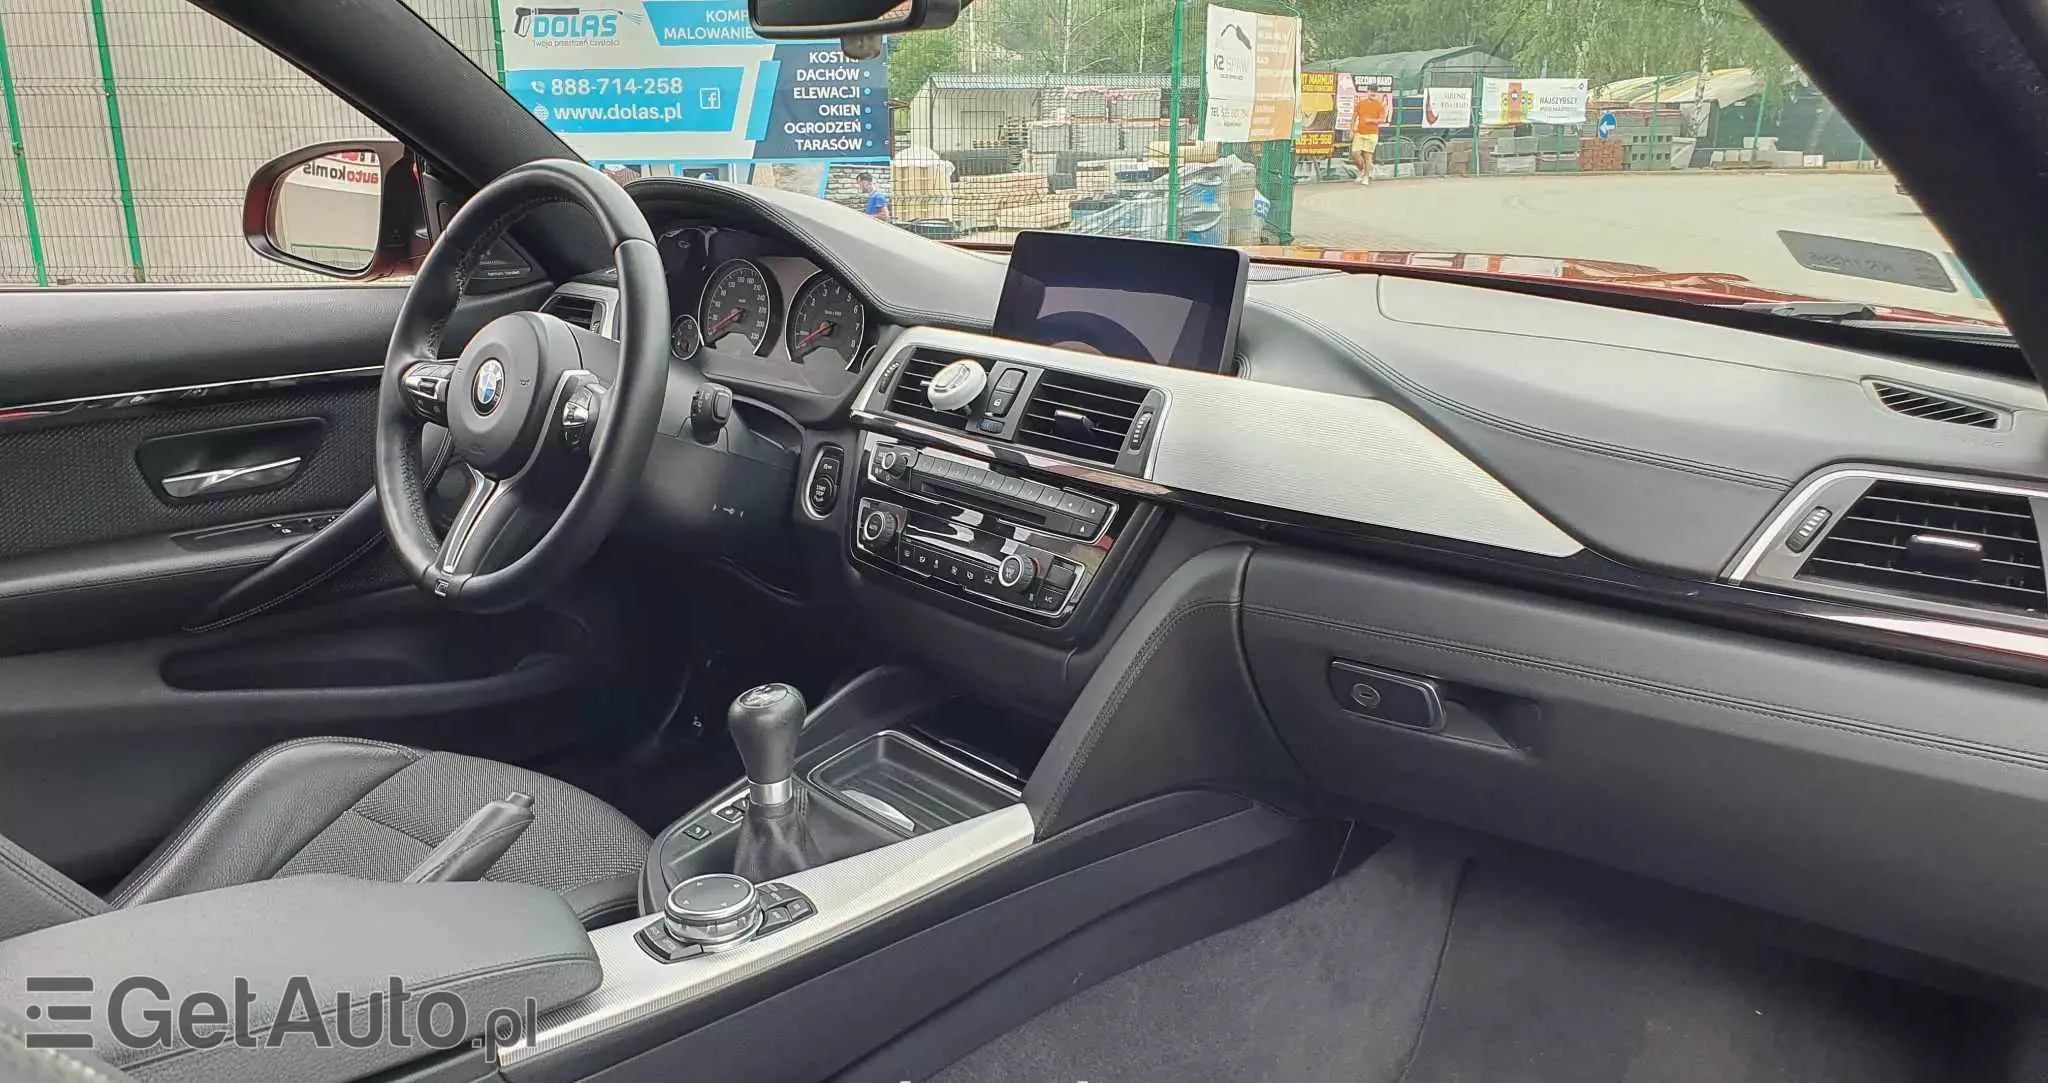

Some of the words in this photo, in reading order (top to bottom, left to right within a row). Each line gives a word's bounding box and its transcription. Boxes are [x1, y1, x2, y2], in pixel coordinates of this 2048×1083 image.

[533, 15, 618, 38] DOLAS
[809, 51, 859, 63] KOST
[796, 66, 860, 81] DACHÓW
[551, 76, 684, 96] 888-714-258
[793, 87, 860, 99] ELEWACJI
[552, 102, 683, 123] www.dolas.pl
[818, 104, 861, 117] OKIEN
[783, 118, 862, 135] OGRODZEŃ
[794, 136, 863, 151] TARASÓW
